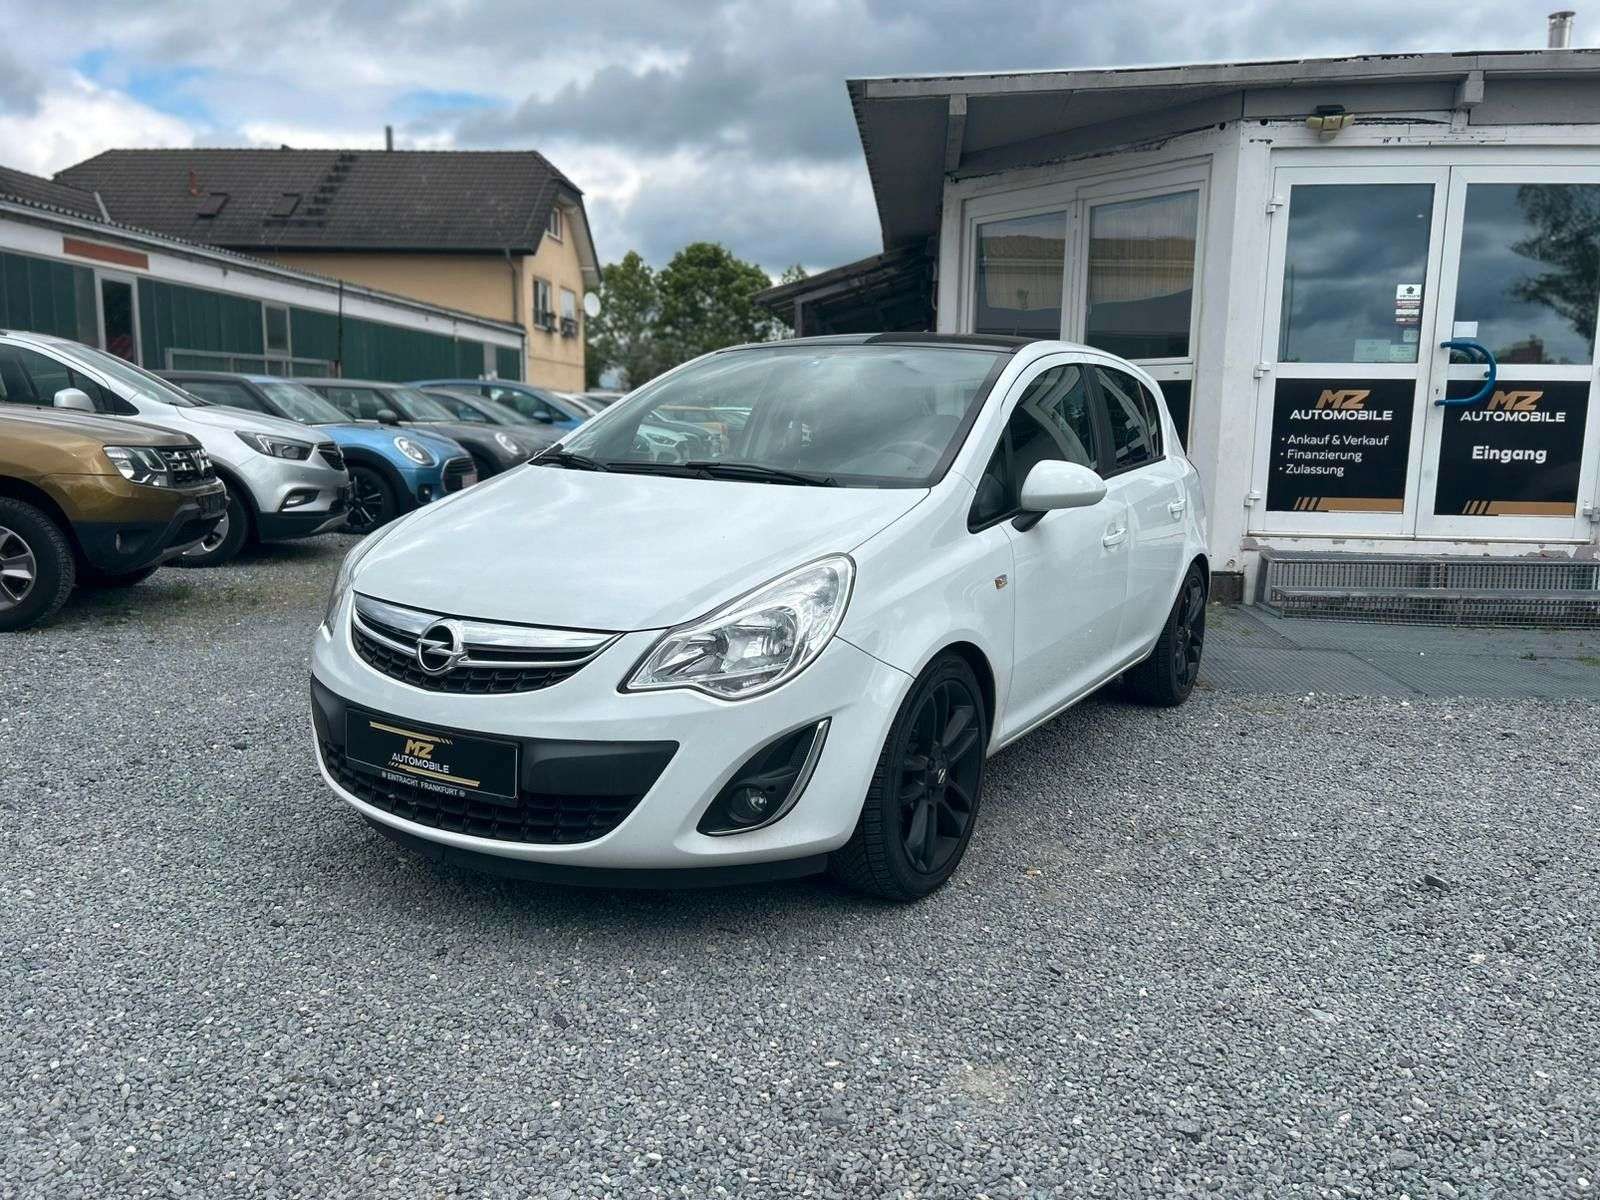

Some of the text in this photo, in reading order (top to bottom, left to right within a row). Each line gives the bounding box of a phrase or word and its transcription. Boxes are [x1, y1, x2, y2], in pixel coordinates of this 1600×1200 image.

[1315, 389, 1371, 409] MZ
[1487, 390, 1544, 411] MZ
[1289, 409, 1393, 421] AUTOMOBILE
[1460, 410, 1566, 422] AUTOMOBILE
[1287, 434, 1390, 446] Ankauf & Verkauf
[1287, 449, 1363, 463] Finanzierung
[1472, 445, 1547, 463] Eingang
[1285, 463, 1344, 477] Zulassung
[404, 738, 434, 759] MZ
[391, 752, 450, 774] AUTOMOBILE
[387, 772, 458, 796] EINTRACHT FRANKFURT
